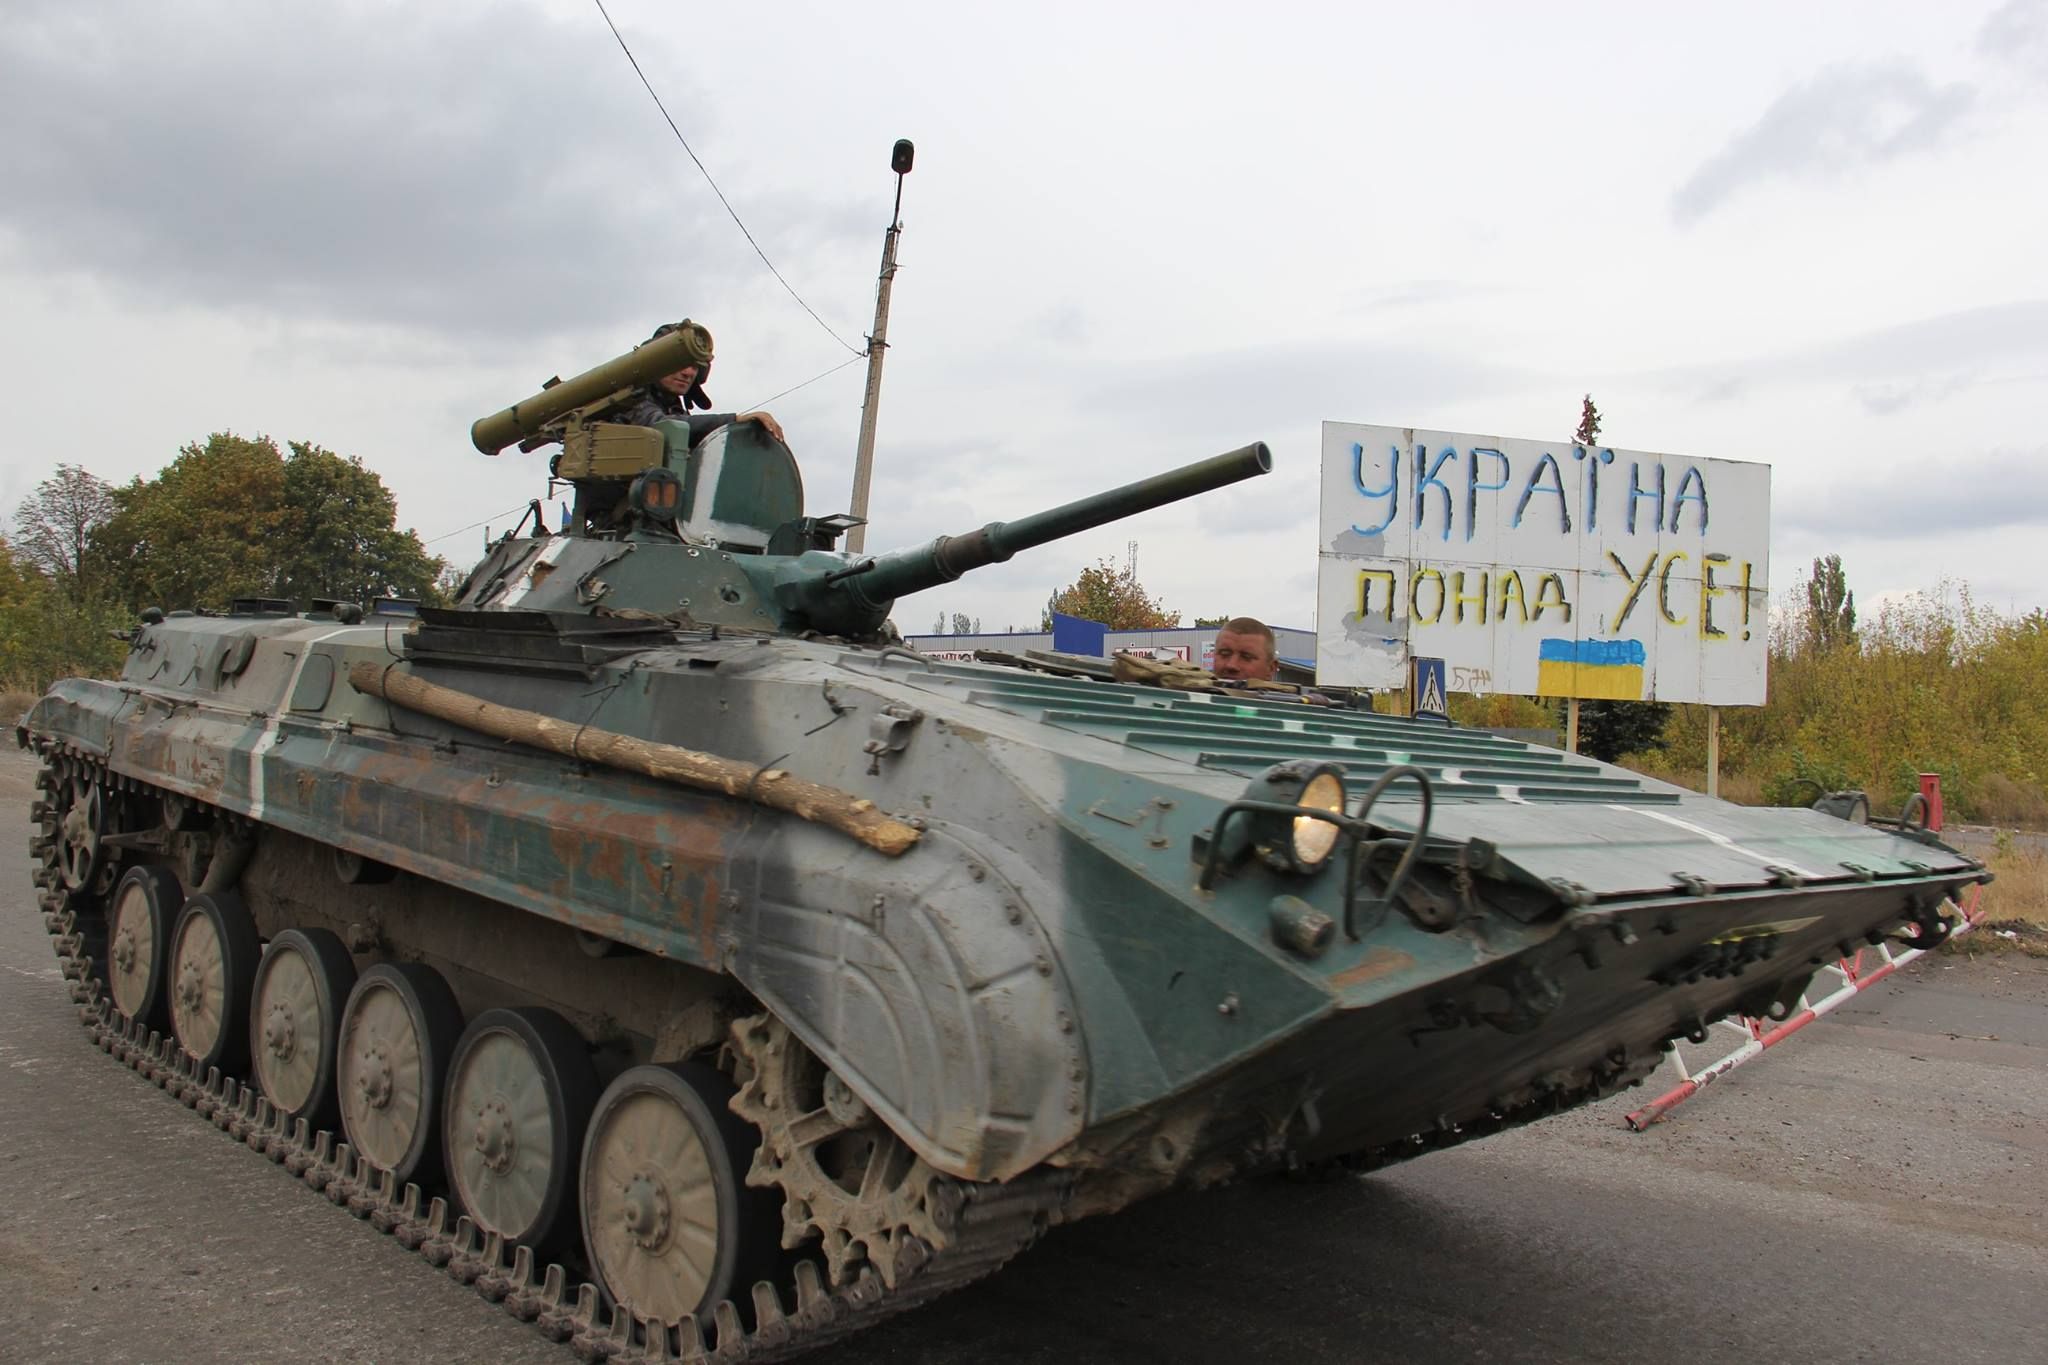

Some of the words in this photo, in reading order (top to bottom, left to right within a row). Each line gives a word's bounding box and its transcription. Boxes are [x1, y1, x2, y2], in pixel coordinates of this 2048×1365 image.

[1352, 441, 1709, 542] УКРАЇНА
[1356, 568, 1572, 626] ПОНАД
[1608, 550, 1752, 641] УСЕ!
